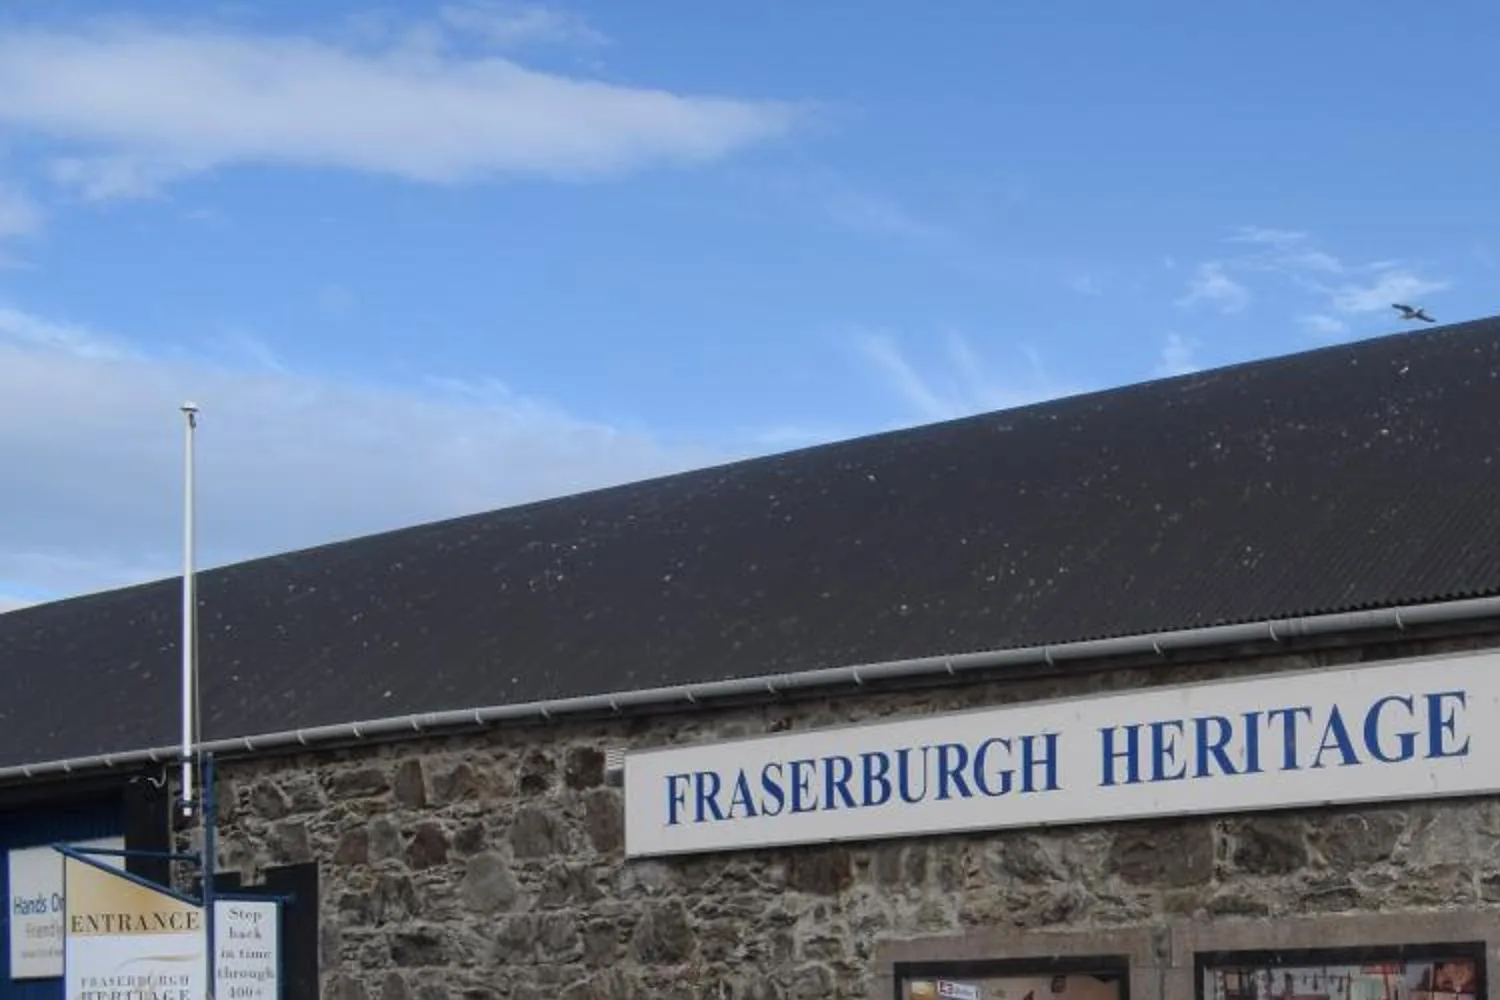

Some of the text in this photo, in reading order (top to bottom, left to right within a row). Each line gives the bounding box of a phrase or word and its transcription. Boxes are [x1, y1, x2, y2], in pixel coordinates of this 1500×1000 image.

[664, 732, 1065, 827] FRASERBURGH
[1097, 690, 1471, 787] HERITAGE
[70, 910, 200, 934] ENTRANCE
[227, 907, 263, 923] Step
[228, 926, 262, 939] back
[81, 975, 190, 988] FRASERBURGH
[218, 965, 275, 982] through
